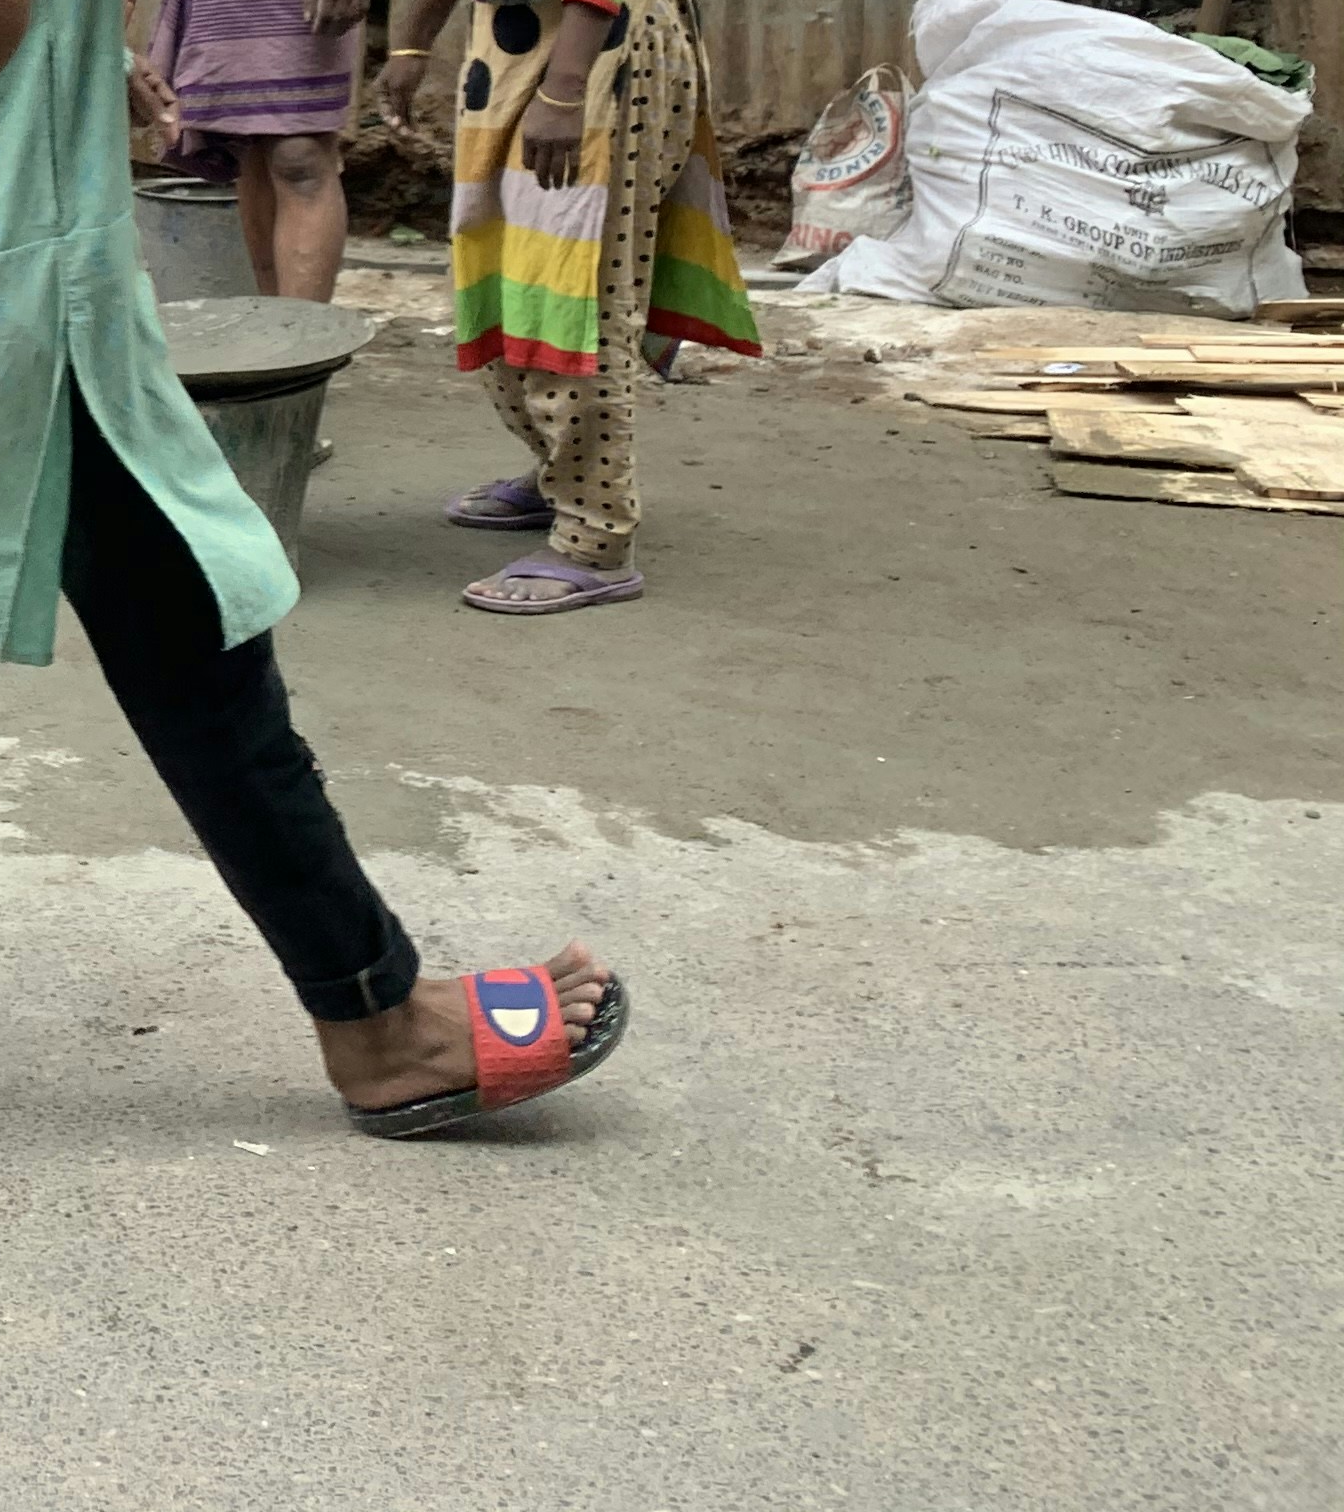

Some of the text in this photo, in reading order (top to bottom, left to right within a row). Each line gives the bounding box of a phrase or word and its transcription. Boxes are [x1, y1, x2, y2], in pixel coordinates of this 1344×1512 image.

[816, 141, 886, 182] RINGS
[1103, 152, 1247, 196] COTTON MILLS
[1013, 194, 1246, 263] T. K. GROUP OF INDUSTRIES
[1122, 225, 1150, 242] UNIT
